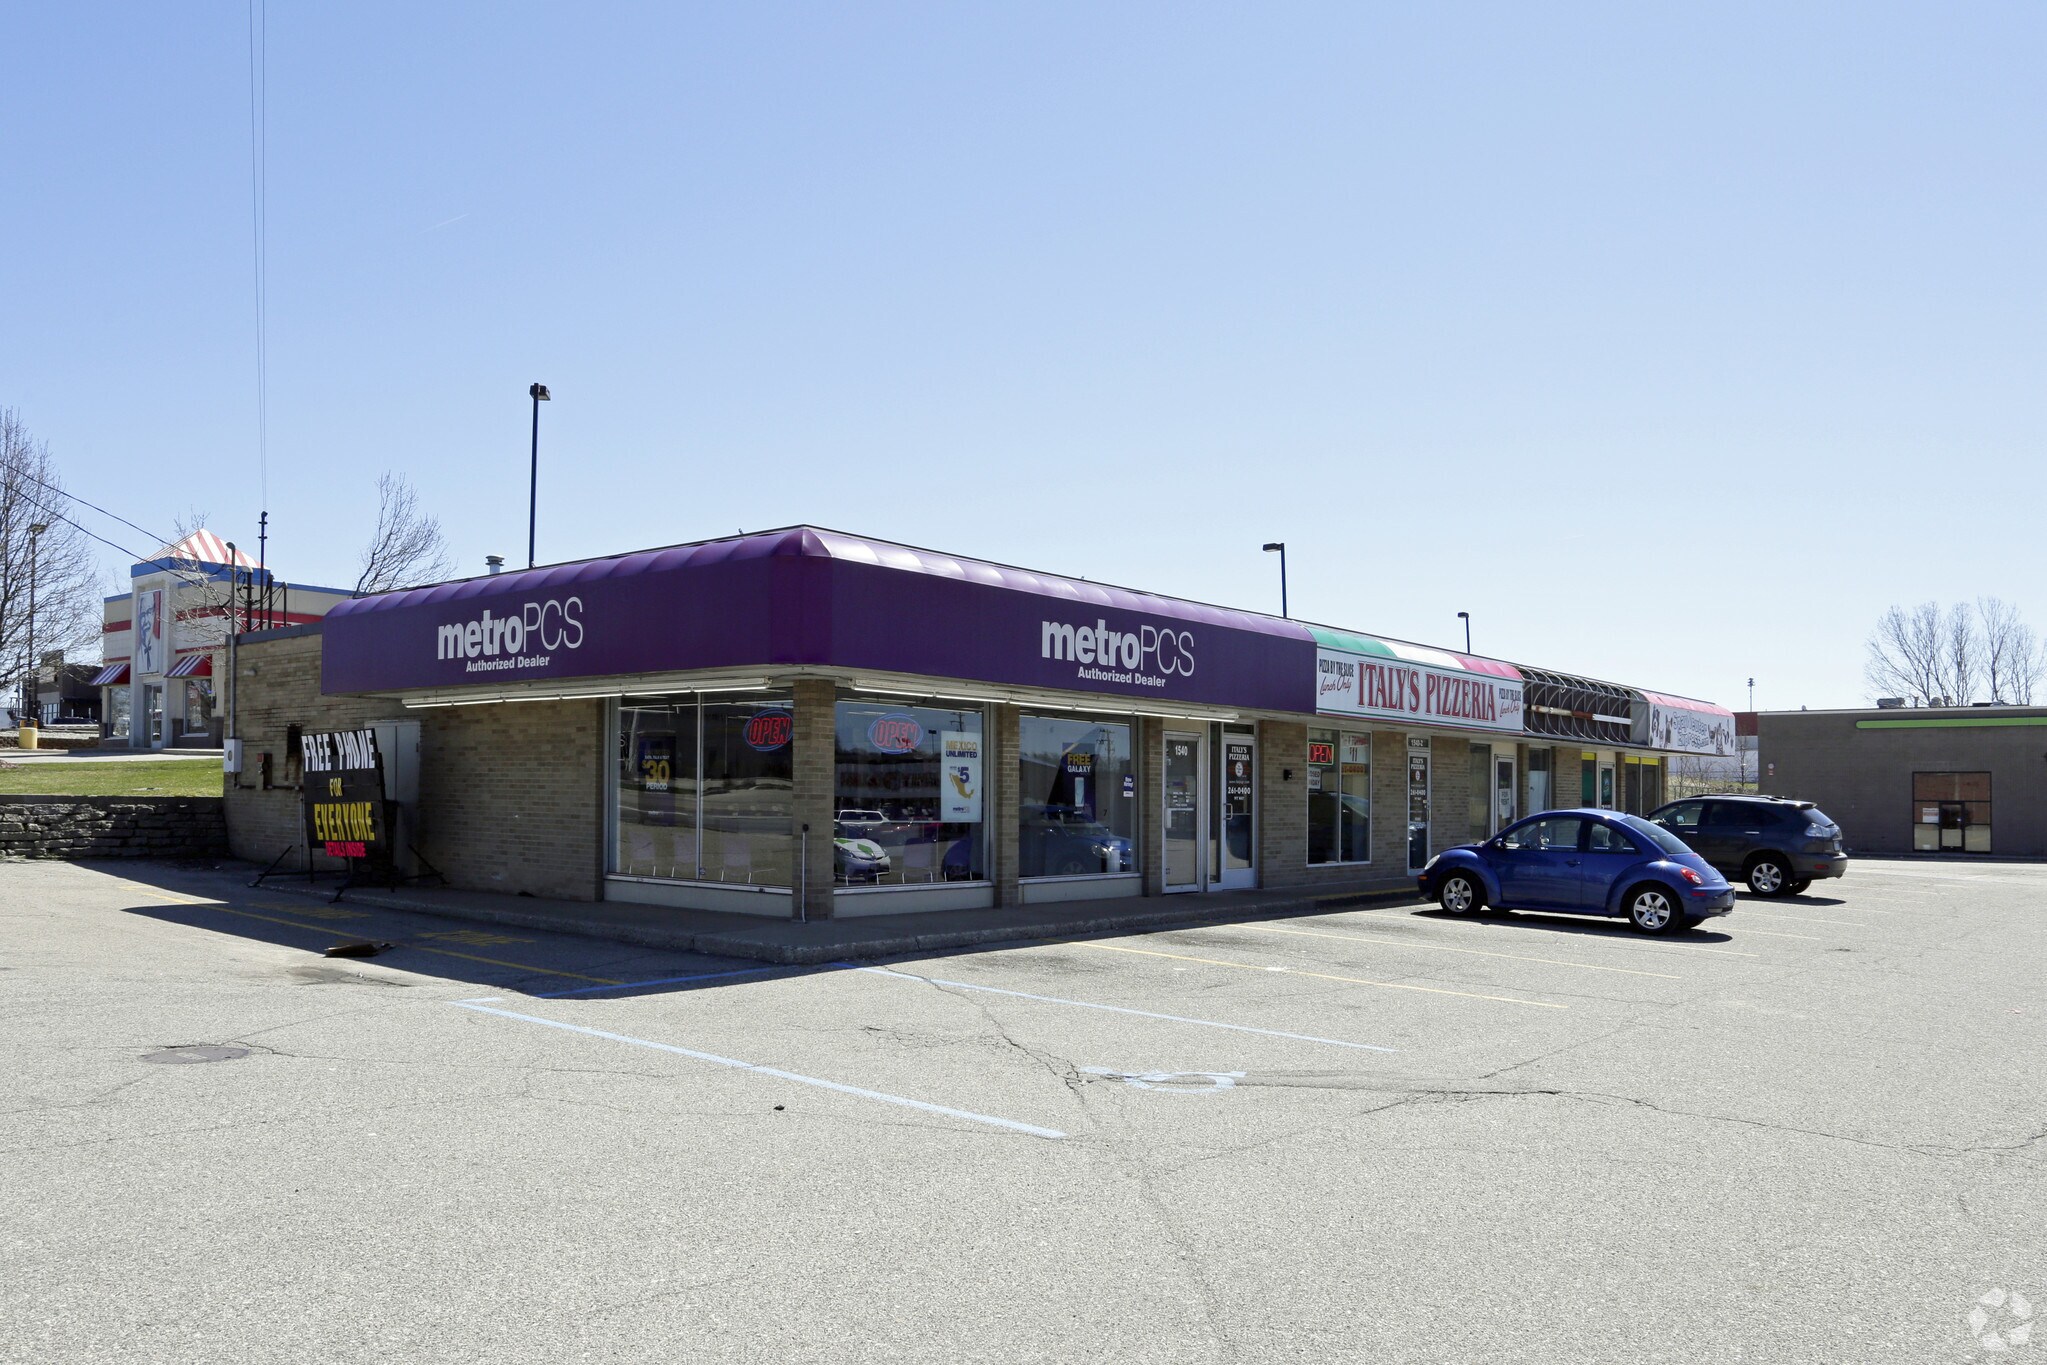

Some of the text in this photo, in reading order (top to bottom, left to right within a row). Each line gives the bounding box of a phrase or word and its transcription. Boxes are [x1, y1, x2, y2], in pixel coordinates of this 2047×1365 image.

[437, 596, 583, 660] metroPCS
[1041, 618, 1195, 677] metroPCS
[466, 654, 550, 673] Authorized Dealer
[1330, 660, 1336, 675] BY
[1077, 666, 1166, 688] Authorized Dealer
[1320, 676, 1336, 696] Lunch
[1357, 660, 1497, 722] ITALY'S PIZZERIA
[750, 717, 791, 745] OPEN
[874, 720, 918, 749] OPEN
[301, 729, 375, 772] FREE PHONE
[945, 751, 978, 759] UNLIMITED
[946, 741, 977, 751] MEXICO
[1175, 745, 1188, 756] 1540
[1231, 746, 1247, 754] ITALY'S
[1309, 744, 1333, 763] OPEN
[1067, 754, 1091, 765] FREE
[1228, 753, 1250, 761] PIZZERIA
[642, 760, 670, 785] $30
[957, 766, 970, 784] $5
[1067, 765, 1091, 773] GALAXY
[329, 777, 343, 797] FOR
[645, 783, 668, 791] PERIOD
[313, 802, 375, 841] EVERYONE
